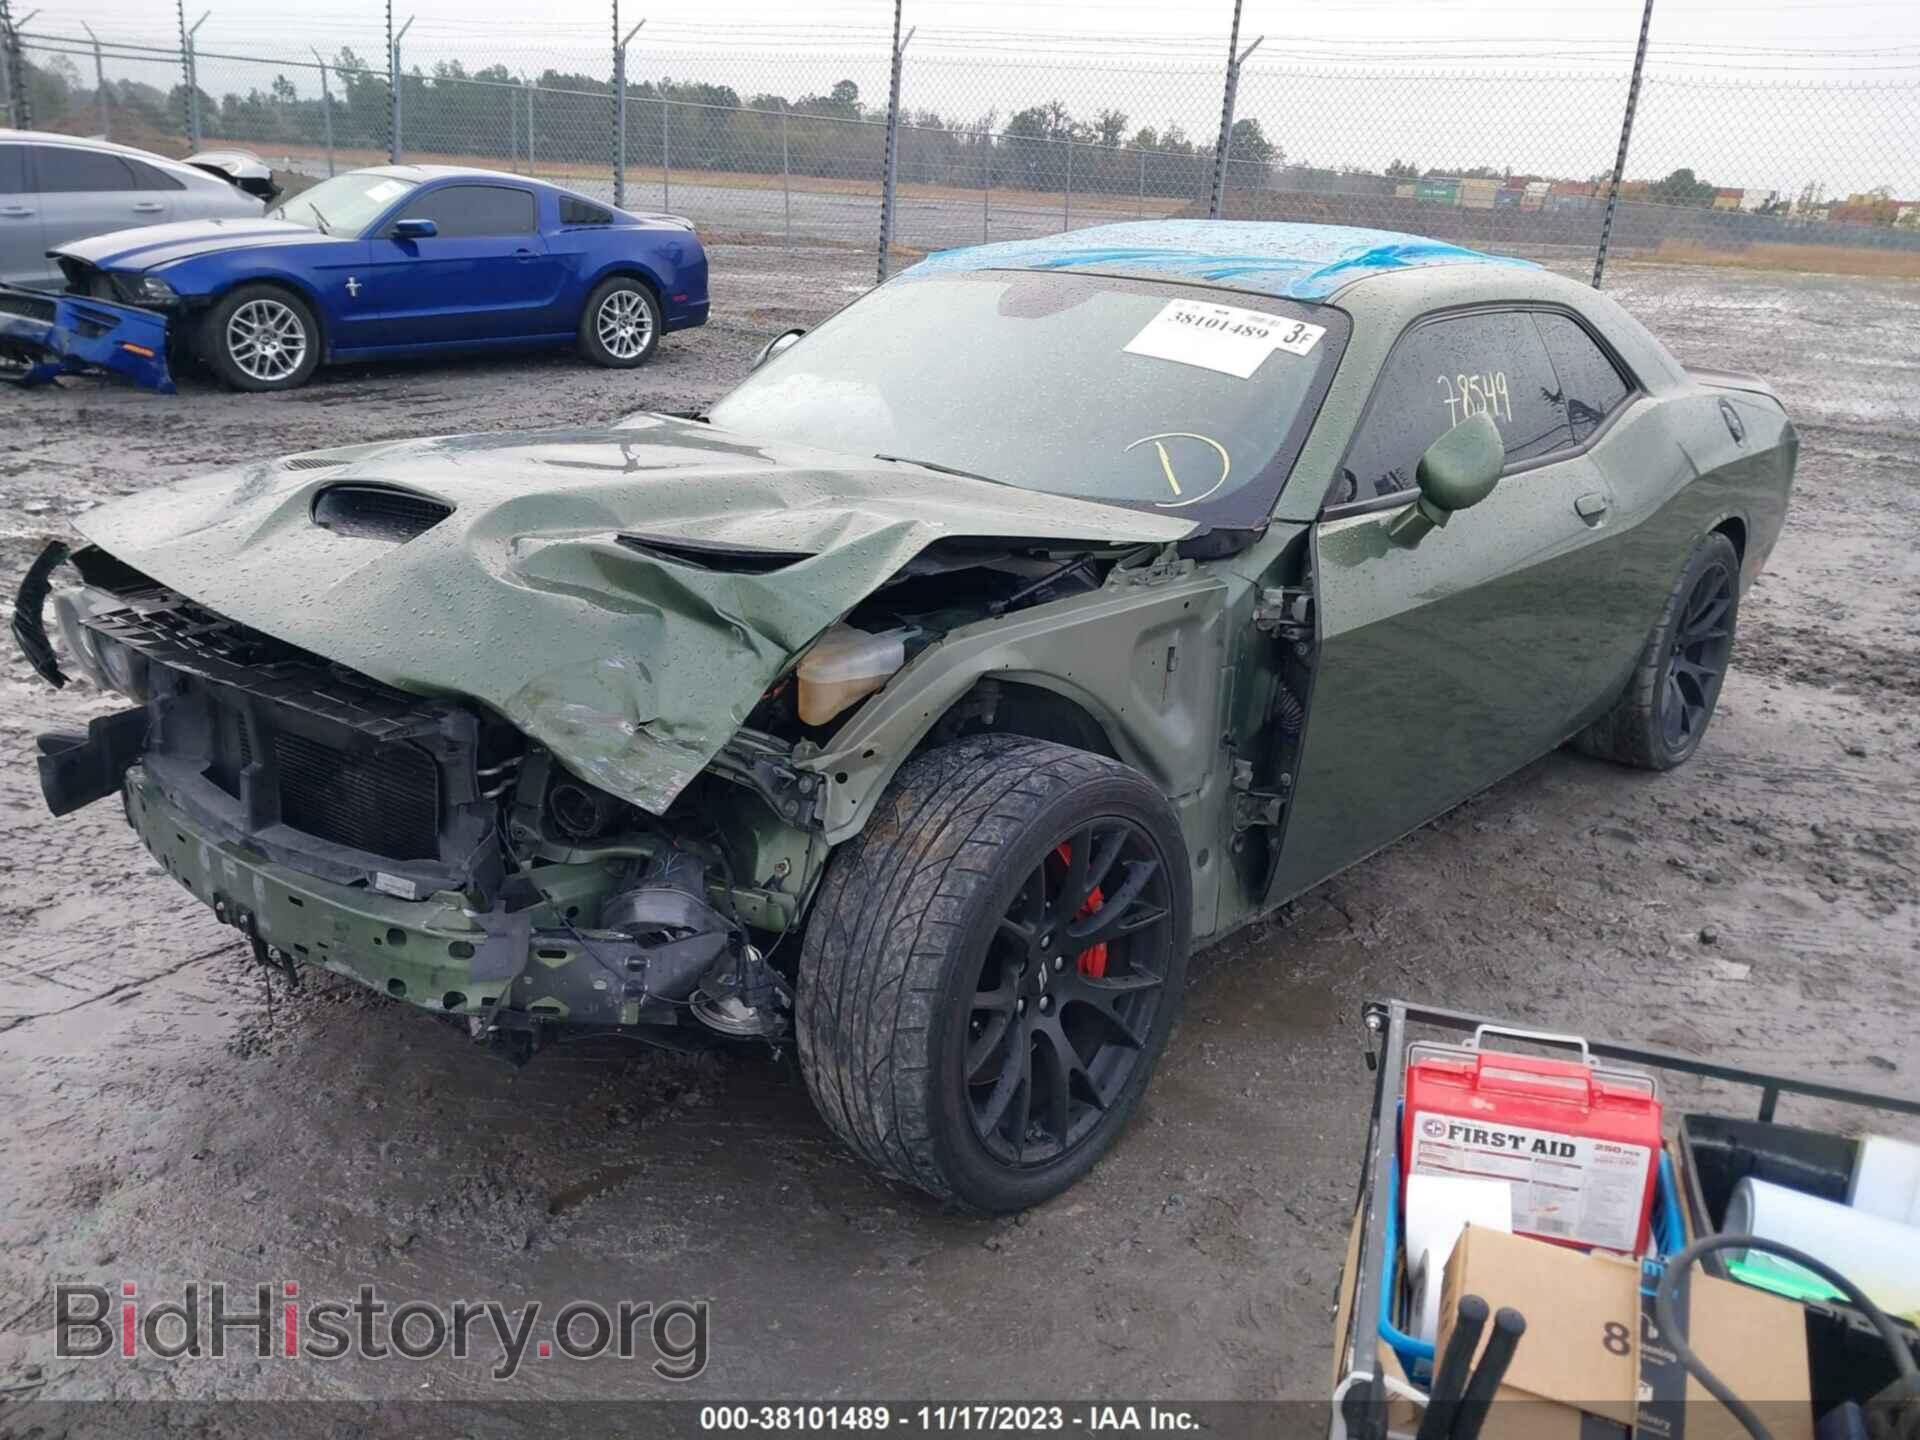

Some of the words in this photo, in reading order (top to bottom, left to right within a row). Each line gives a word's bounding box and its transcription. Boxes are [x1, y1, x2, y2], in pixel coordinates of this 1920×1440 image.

[1168, 311, 1269, 338] 38101489
[1437, 371, 1512, 428] 78549
[1448, 1124, 1526, 1150] FIRST
[1531, 1138, 1577, 1158] AID
[1603, 1322, 1631, 1356] 8
